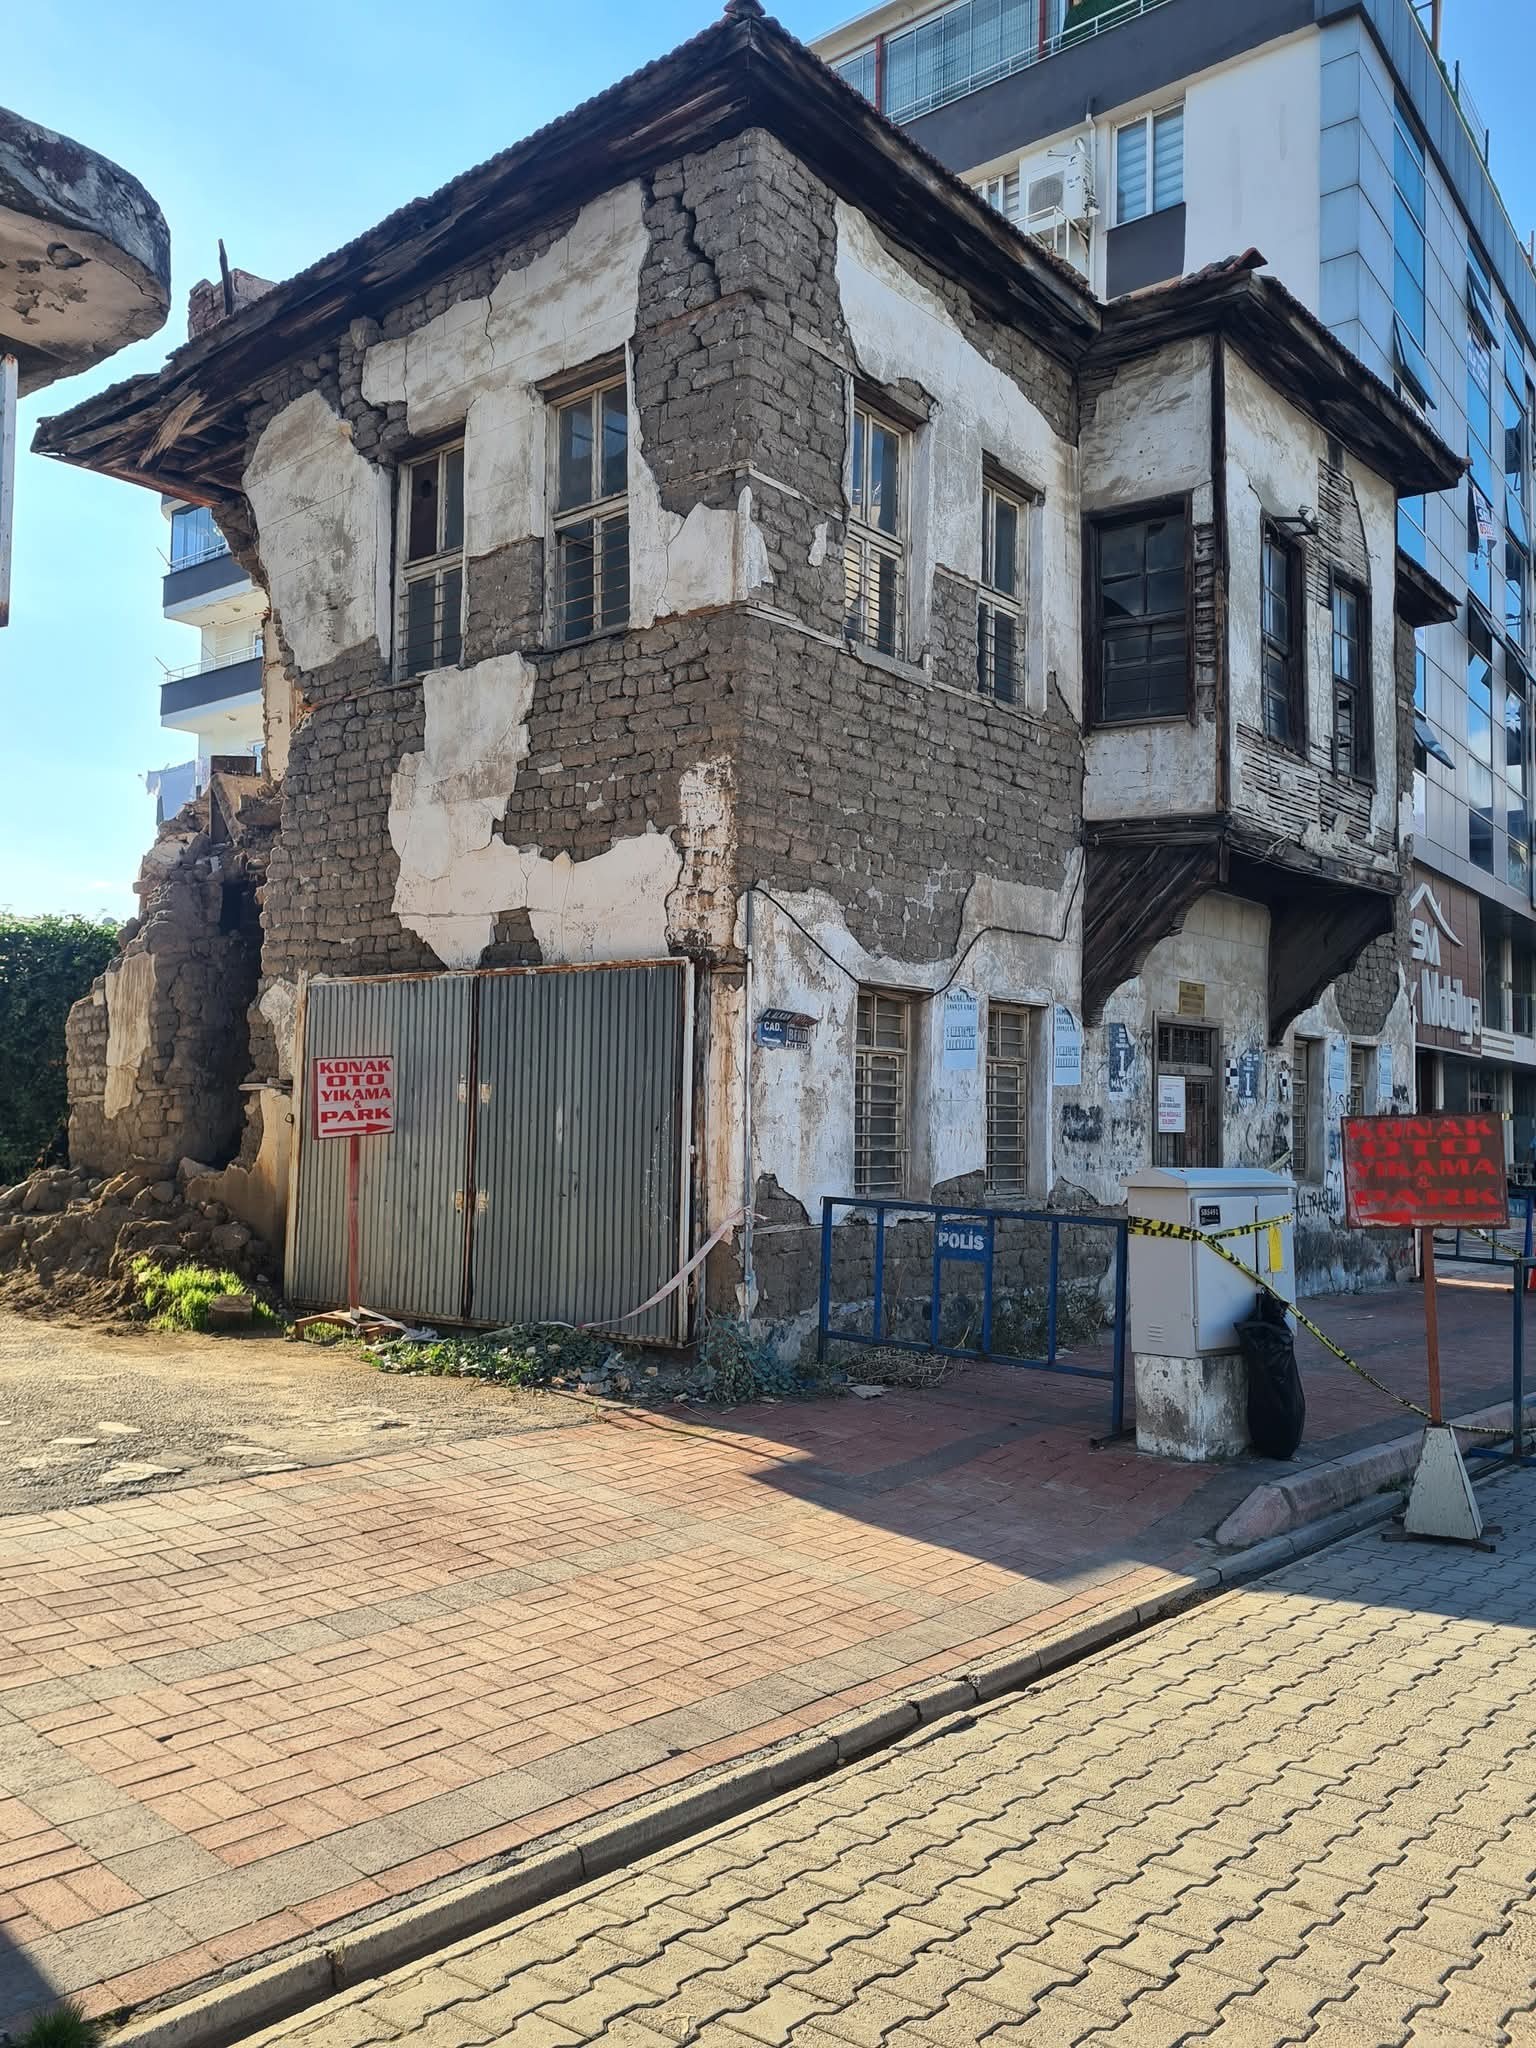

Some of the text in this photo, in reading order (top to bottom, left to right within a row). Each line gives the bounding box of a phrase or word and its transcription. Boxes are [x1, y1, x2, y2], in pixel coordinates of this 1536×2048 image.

[1411, 918, 1441, 966] SM
[1421, 968, 1481, 1045] Mobilya
[763, 1021, 783, 1032] CAD.
[319, 1060, 392, 1074] KONAK
[326, 1073, 385, 1087] OTO
[320, 1087, 392, 1102] YIKAMA
[353, 1100, 362, 1109] &
[320, 1107, 392, 1123] PARK
[1348, 1118, 1495, 1140] KONAK
[1360, 1138, 1481, 1158] OTO
[1352, 1157, 1497, 1178] YIKAMA
[1416, 1175, 1432, 1189] &
[1354, 1187, 1501, 1207] PARK
[938, 1229, 985, 1251] POLİS
